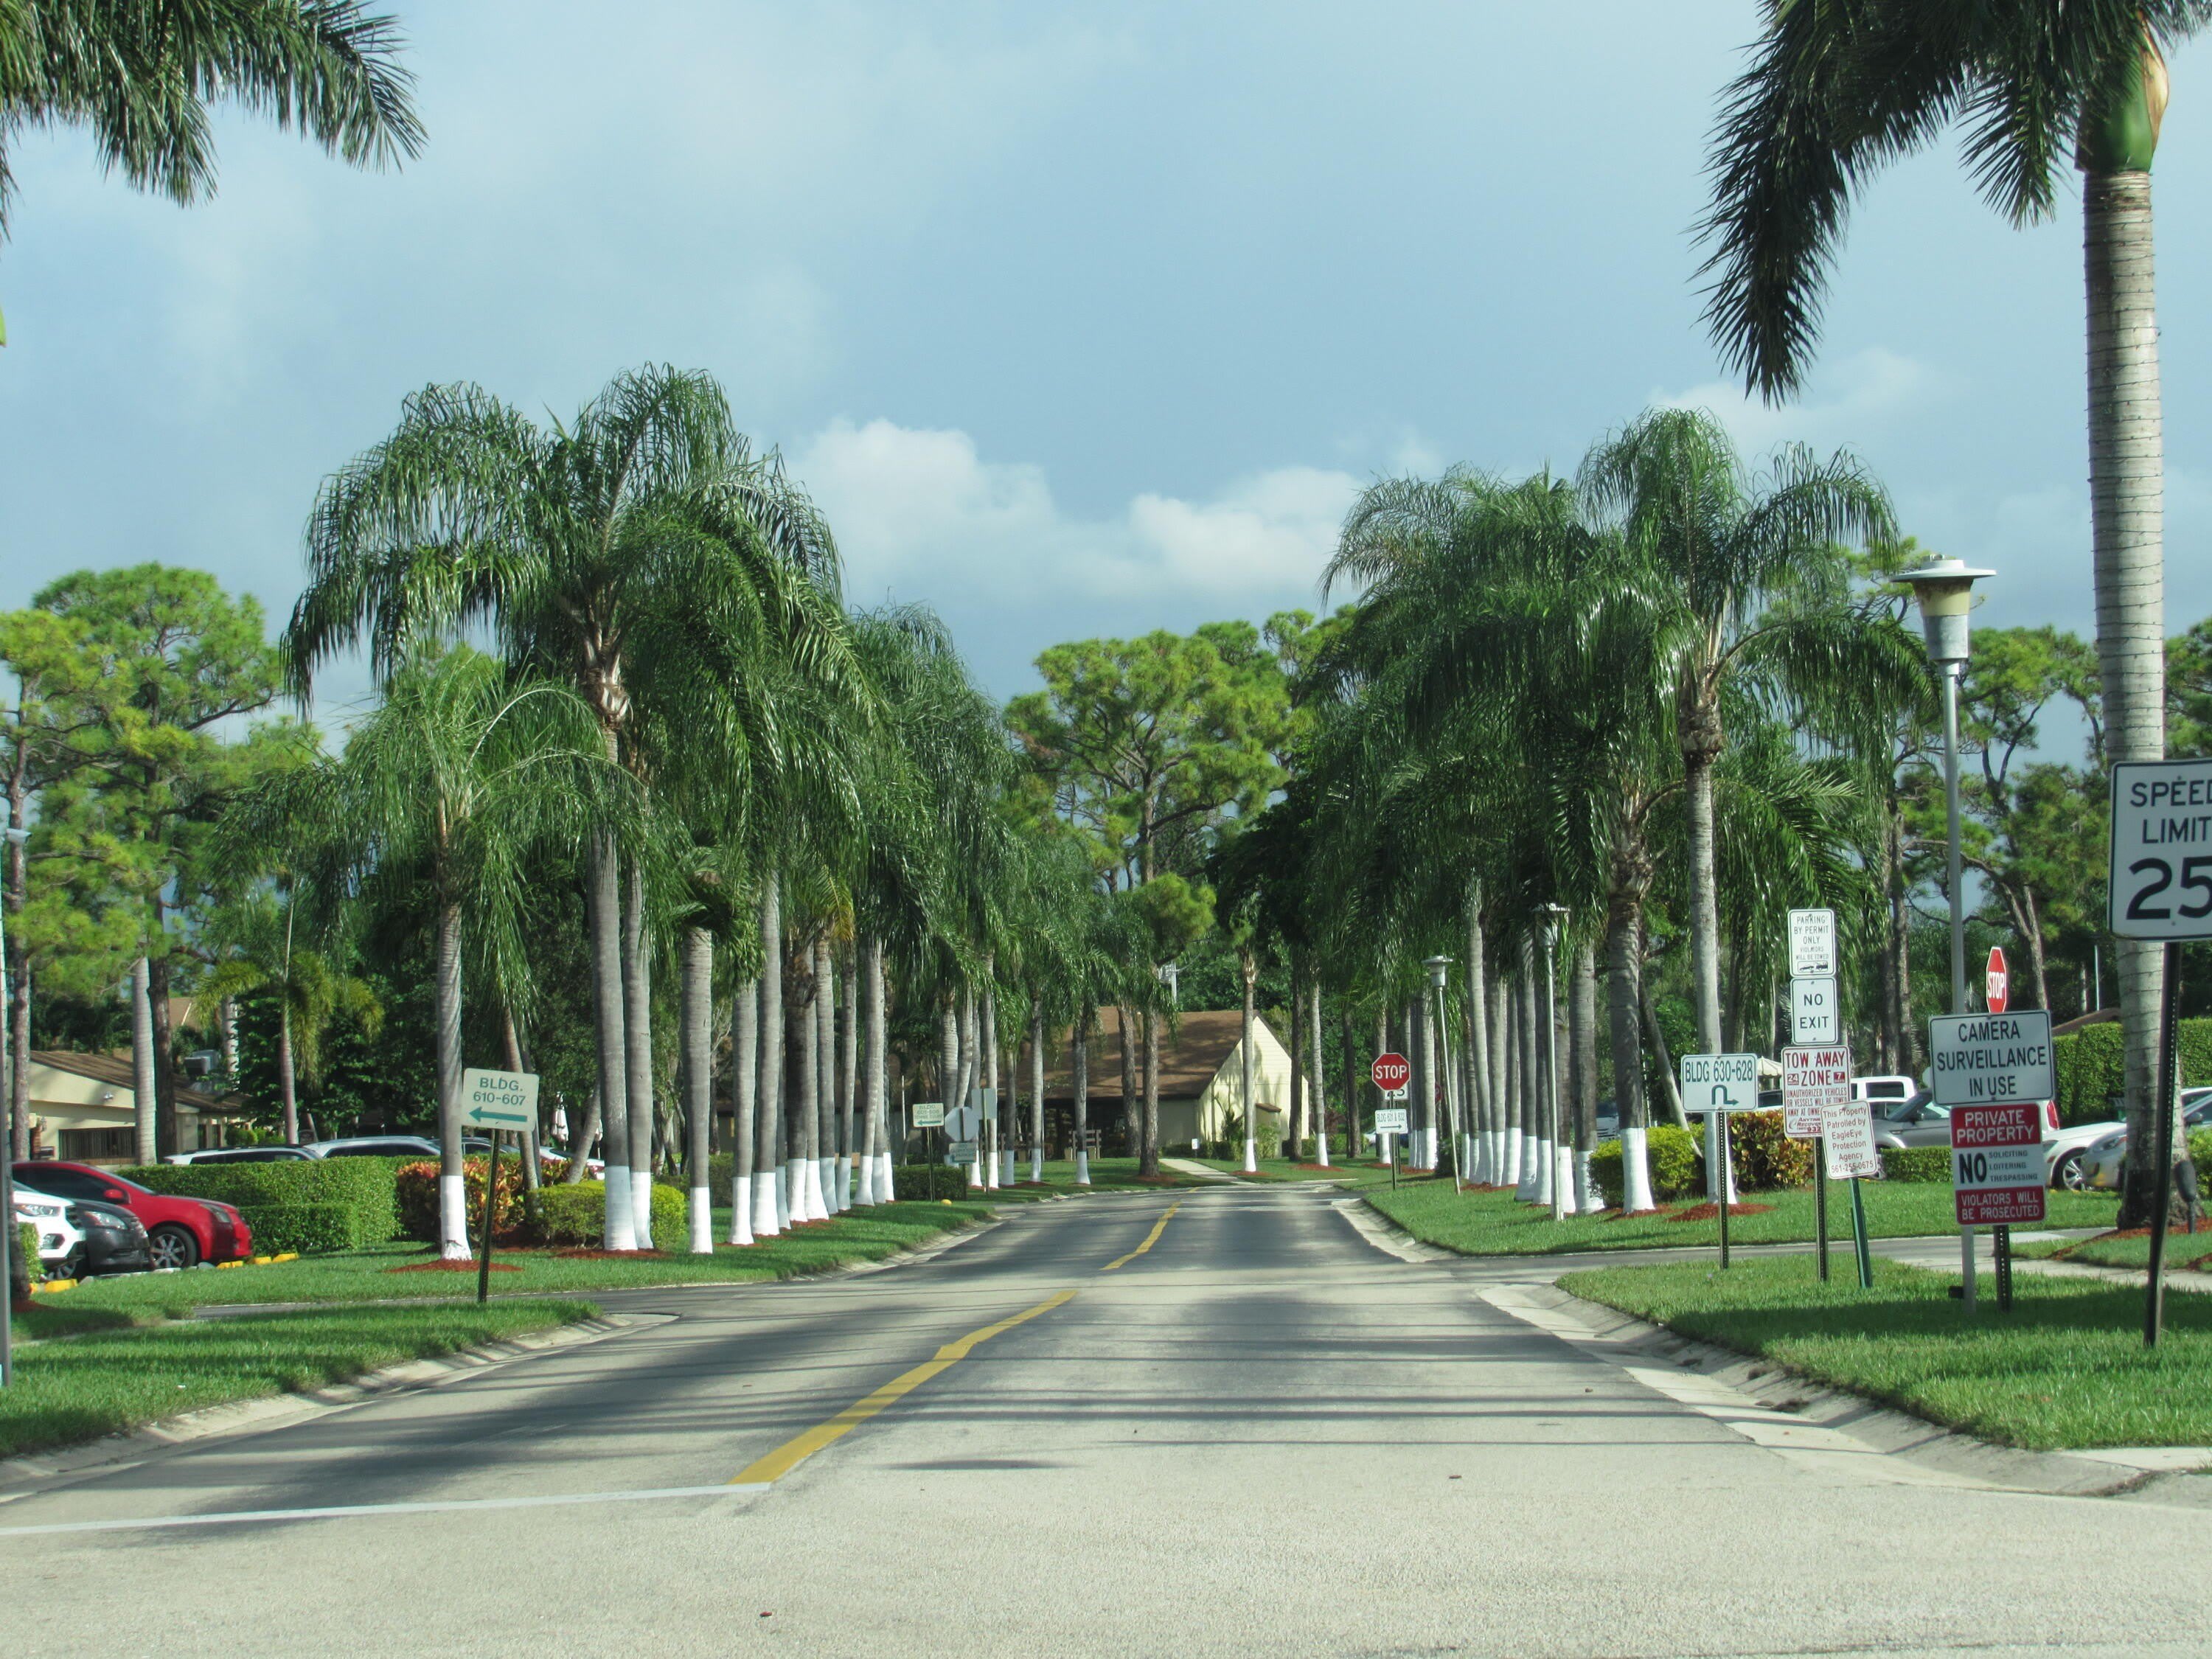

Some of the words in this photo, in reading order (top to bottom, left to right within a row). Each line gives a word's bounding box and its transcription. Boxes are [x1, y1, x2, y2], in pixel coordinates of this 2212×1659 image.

[2142, 816, 2212, 844] LIMIT
[2126, 856, 2212, 919] 25
[1797, 916, 1826, 925] PARKING
[1805, 925, 1829, 934] PERMIT
[1988, 971, 2005, 999] STOP
[1804, 993, 1823, 1006] NO
[1800, 1016, 1829, 1029] EXIT
[1958, 1020, 2020, 1042] CAMERA
[1785, 1052, 1809, 1068] TOW
[1815, 1051, 1845, 1068] AWAY
[1937, 1046, 2047, 1071] SURVEILLANCE
[1375, 1065, 1407, 1079] STOP
[1686, 1061, 1709, 1082] BLDG
[1714, 1060, 1753, 1082] 630-628
[1801, 1070, 1832, 1086] ZONE
[479, 1077, 523, 1091] BLDG.
[1969, 1078, 1983, 1096] IN
[1988, 1076, 2017, 1095] USE
[473, 1091, 526, 1105] 610-607
[1787, 1089, 1823, 1097] UNAUTHORIZED
[1825, 1088, 1847, 1096] VEHICLES
[1795, 1098, 1813, 1106] VESSELS
[1807, 1107, 1820, 1116] OWNE
[1839, 1107, 1867, 1116] Property
[1965, 1110, 2025, 1127] PRIVATE
[1827, 1118, 1857, 1129] Patrolled
[1858, 1118, 1866, 1126] by
[1832, 1130, 1863, 1141] EagleEye
[1957, 1125, 2034, 1143] PROPERTY
[1832, 1141, 1866, 1150] Protection
[1838, 1152, 1863, 1162] Agency
[1989, 1150, 2028, 1158] SOLICITING
[1958, 1152, 1987, 1183] NO
[1989, 1162, 2027, 1170] LOITERING
[1990, 1173, 2038, 1182] TRESPASSING
[1961, 1193, 2011, 1206] VIOLATORS
[2017, 1192, 2039, 1203] WILL
[1962, 1208, 1975, 1220] BE
[1980, 1205, 2039, 1219] PROSECUTED
